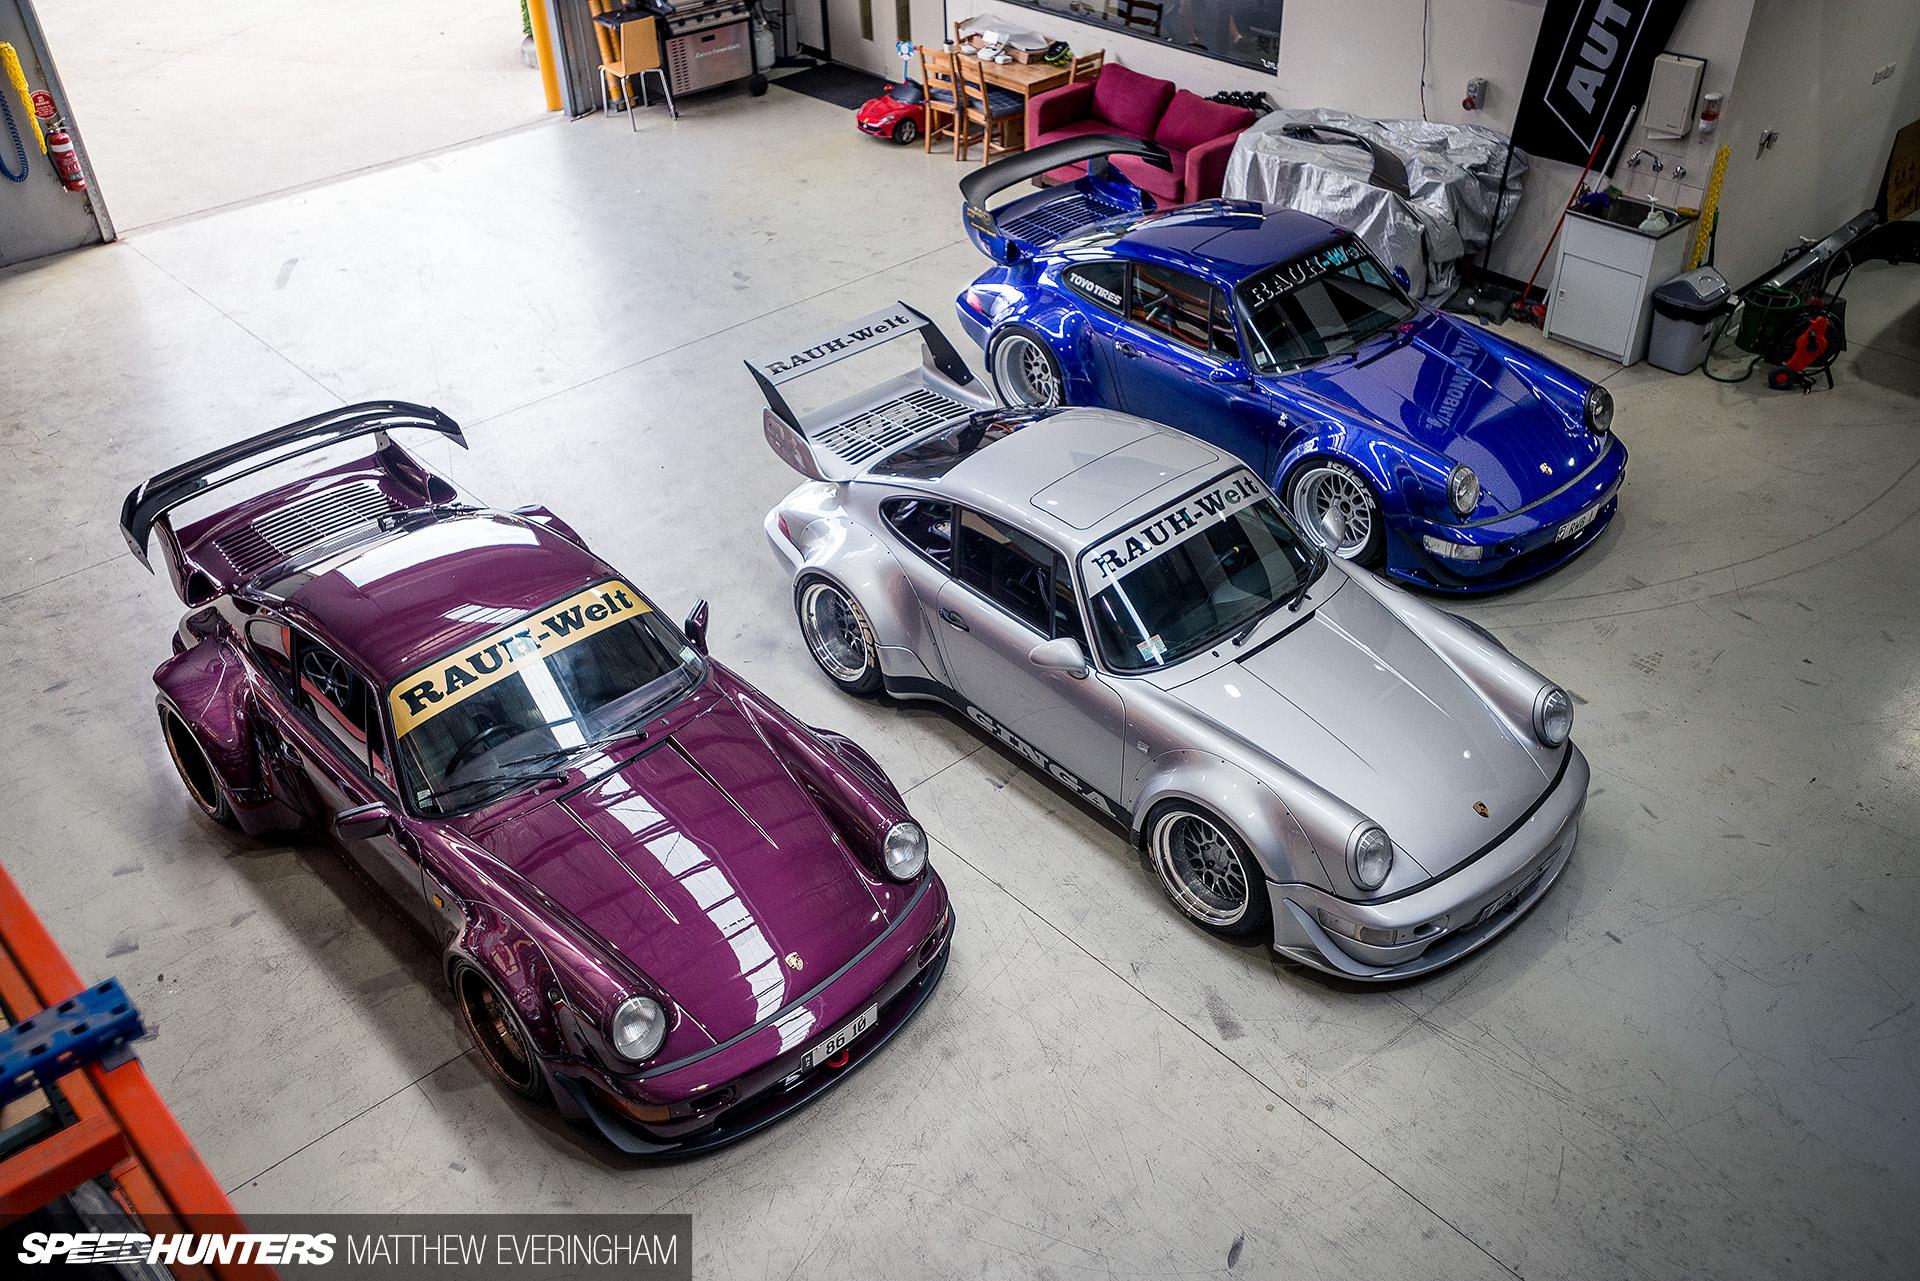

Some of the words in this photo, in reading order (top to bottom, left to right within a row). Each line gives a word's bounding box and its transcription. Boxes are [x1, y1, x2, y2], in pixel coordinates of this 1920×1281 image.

[1070, 272, 1096, 292] TOYO
[1095, 282, 1122, 306] TIRES
[764, 314, 910, 376] RAUH-Welt
[1091, 476, 1260, 579] RAUH-Welt
[826, 1033, 846, 1055] 86
